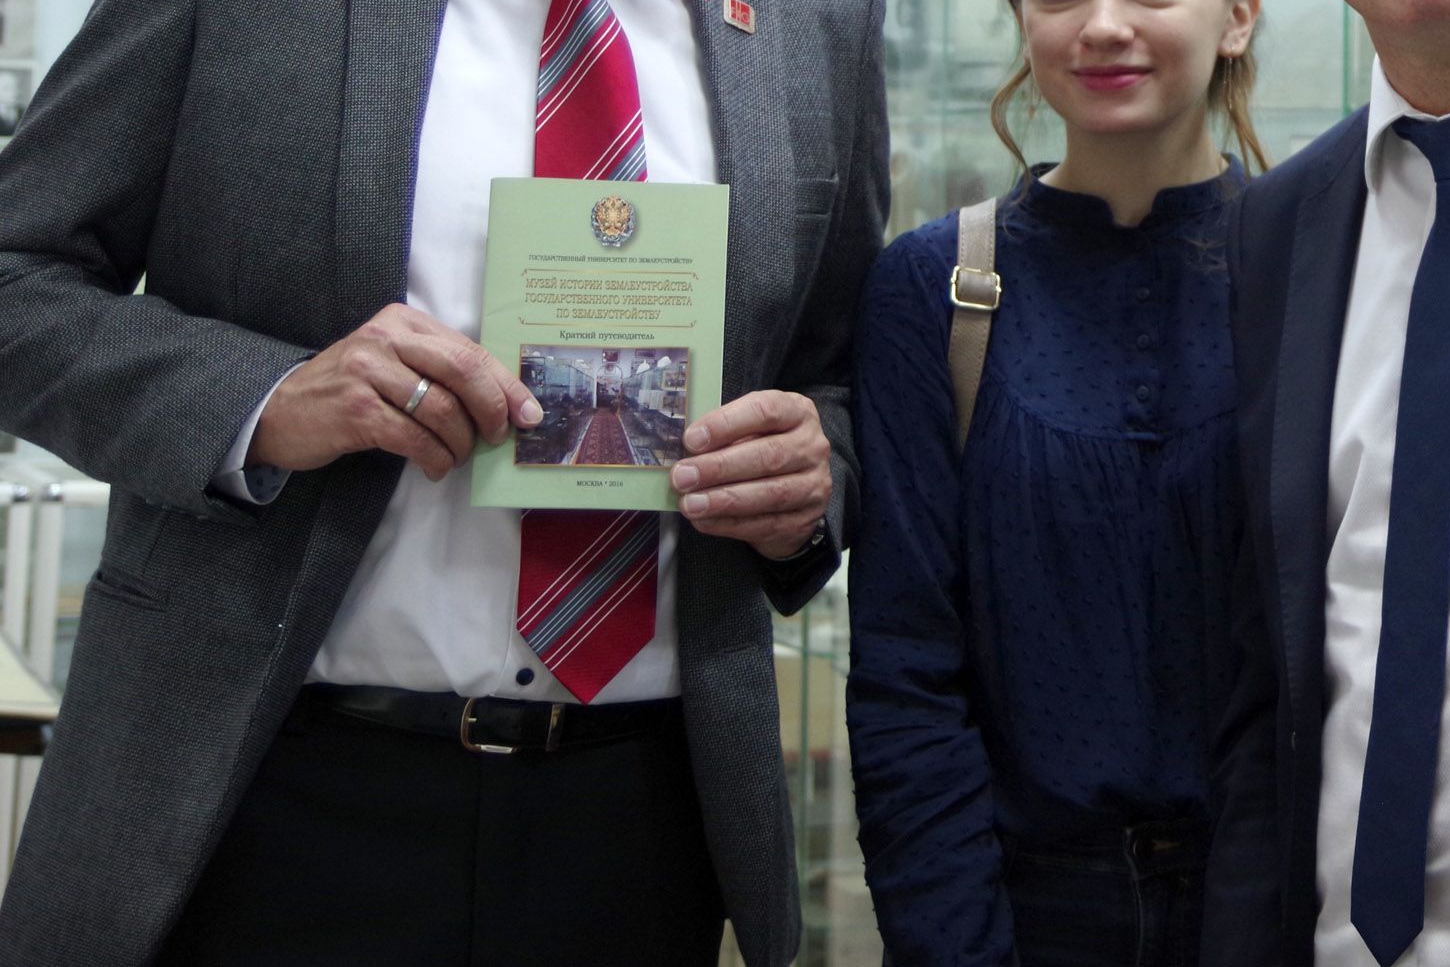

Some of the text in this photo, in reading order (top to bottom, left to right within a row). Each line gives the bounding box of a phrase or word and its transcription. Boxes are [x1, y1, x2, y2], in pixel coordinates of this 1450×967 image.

[526, 277, 694, 292] МУЗЕЙ ИСТОРИИ ЗЕМЛЕУСТРОЙСТВА
[525, 292, 693, 306] ГОСУДАРСТВЕННОГО УНИВЕРСИТЕТА
[556, 307, 662, 321] ПО ЗЕМЛЕУСТРОЙСТВУ
[559, 330, 655, 341] Краткий путеводитель
